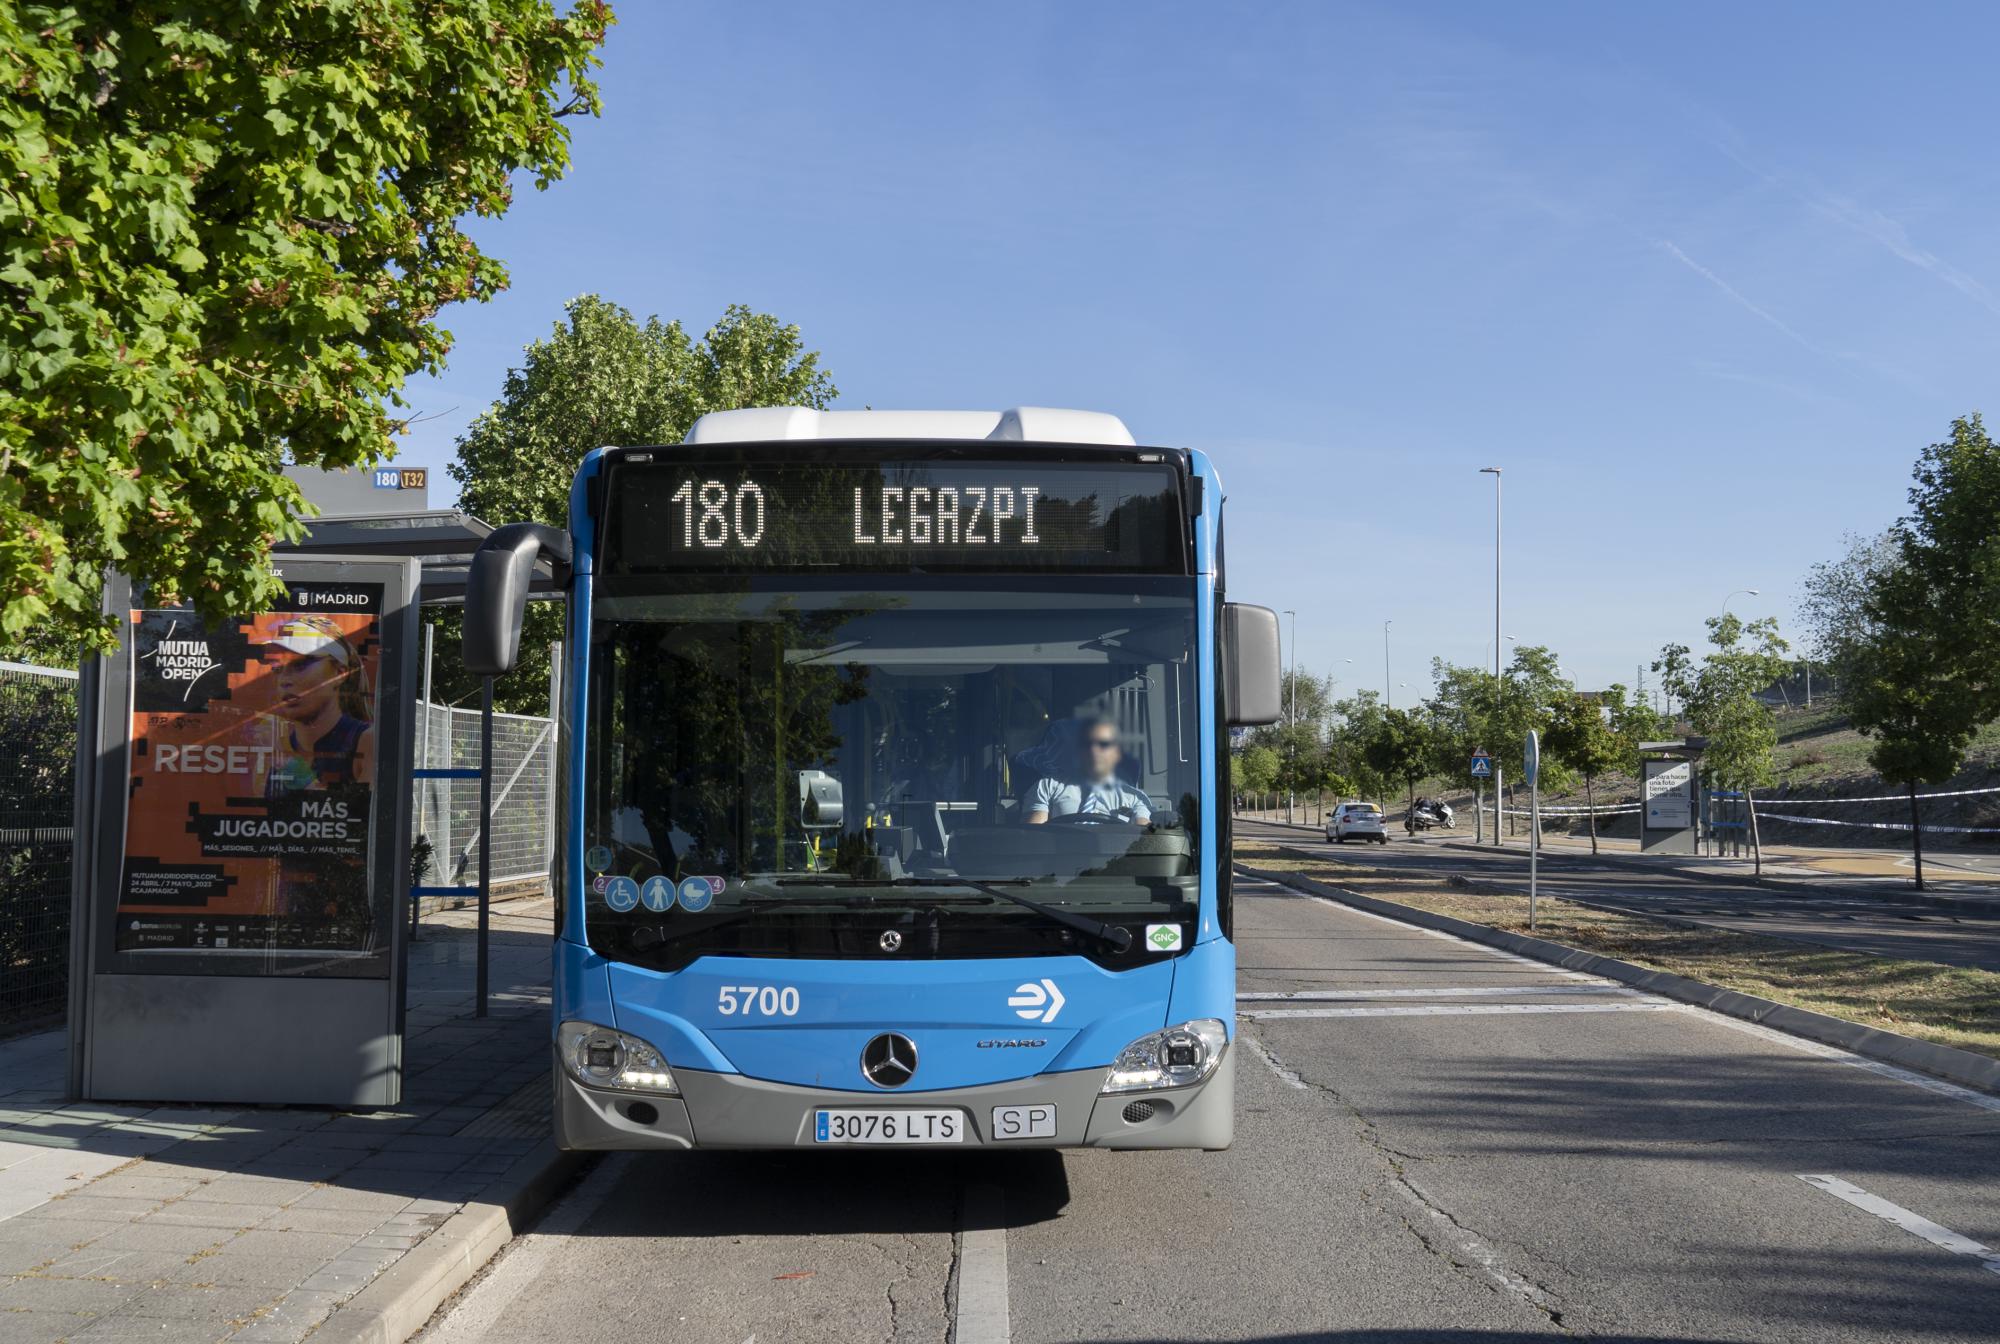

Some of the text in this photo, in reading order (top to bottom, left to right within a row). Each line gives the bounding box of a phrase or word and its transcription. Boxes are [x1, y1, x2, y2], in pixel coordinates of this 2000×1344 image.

[376, 471, 424, 487] 180 T32
[671, 480, 1039, 547] 180 LEGAZPI
[315, 593, 369, 605] MADRID
[158, 640, 209, 656] MUTUA
[156, 656, 212, 668] MADRID
[161, 668, 203, 680] OPEN
[597, 878, 605, 889] 2
[713, 878, 721, 889] 4
[1153, 933, 1175, 942] GNC
[718, 986, 800, 1016] 5700
[976, 1039, 1048, 1049] CITARO
[832, 1115, 897, 1139] 3076
[906, 1115, 954, 1139] LTS
[1003, 1109, 1048, 1134] SP
